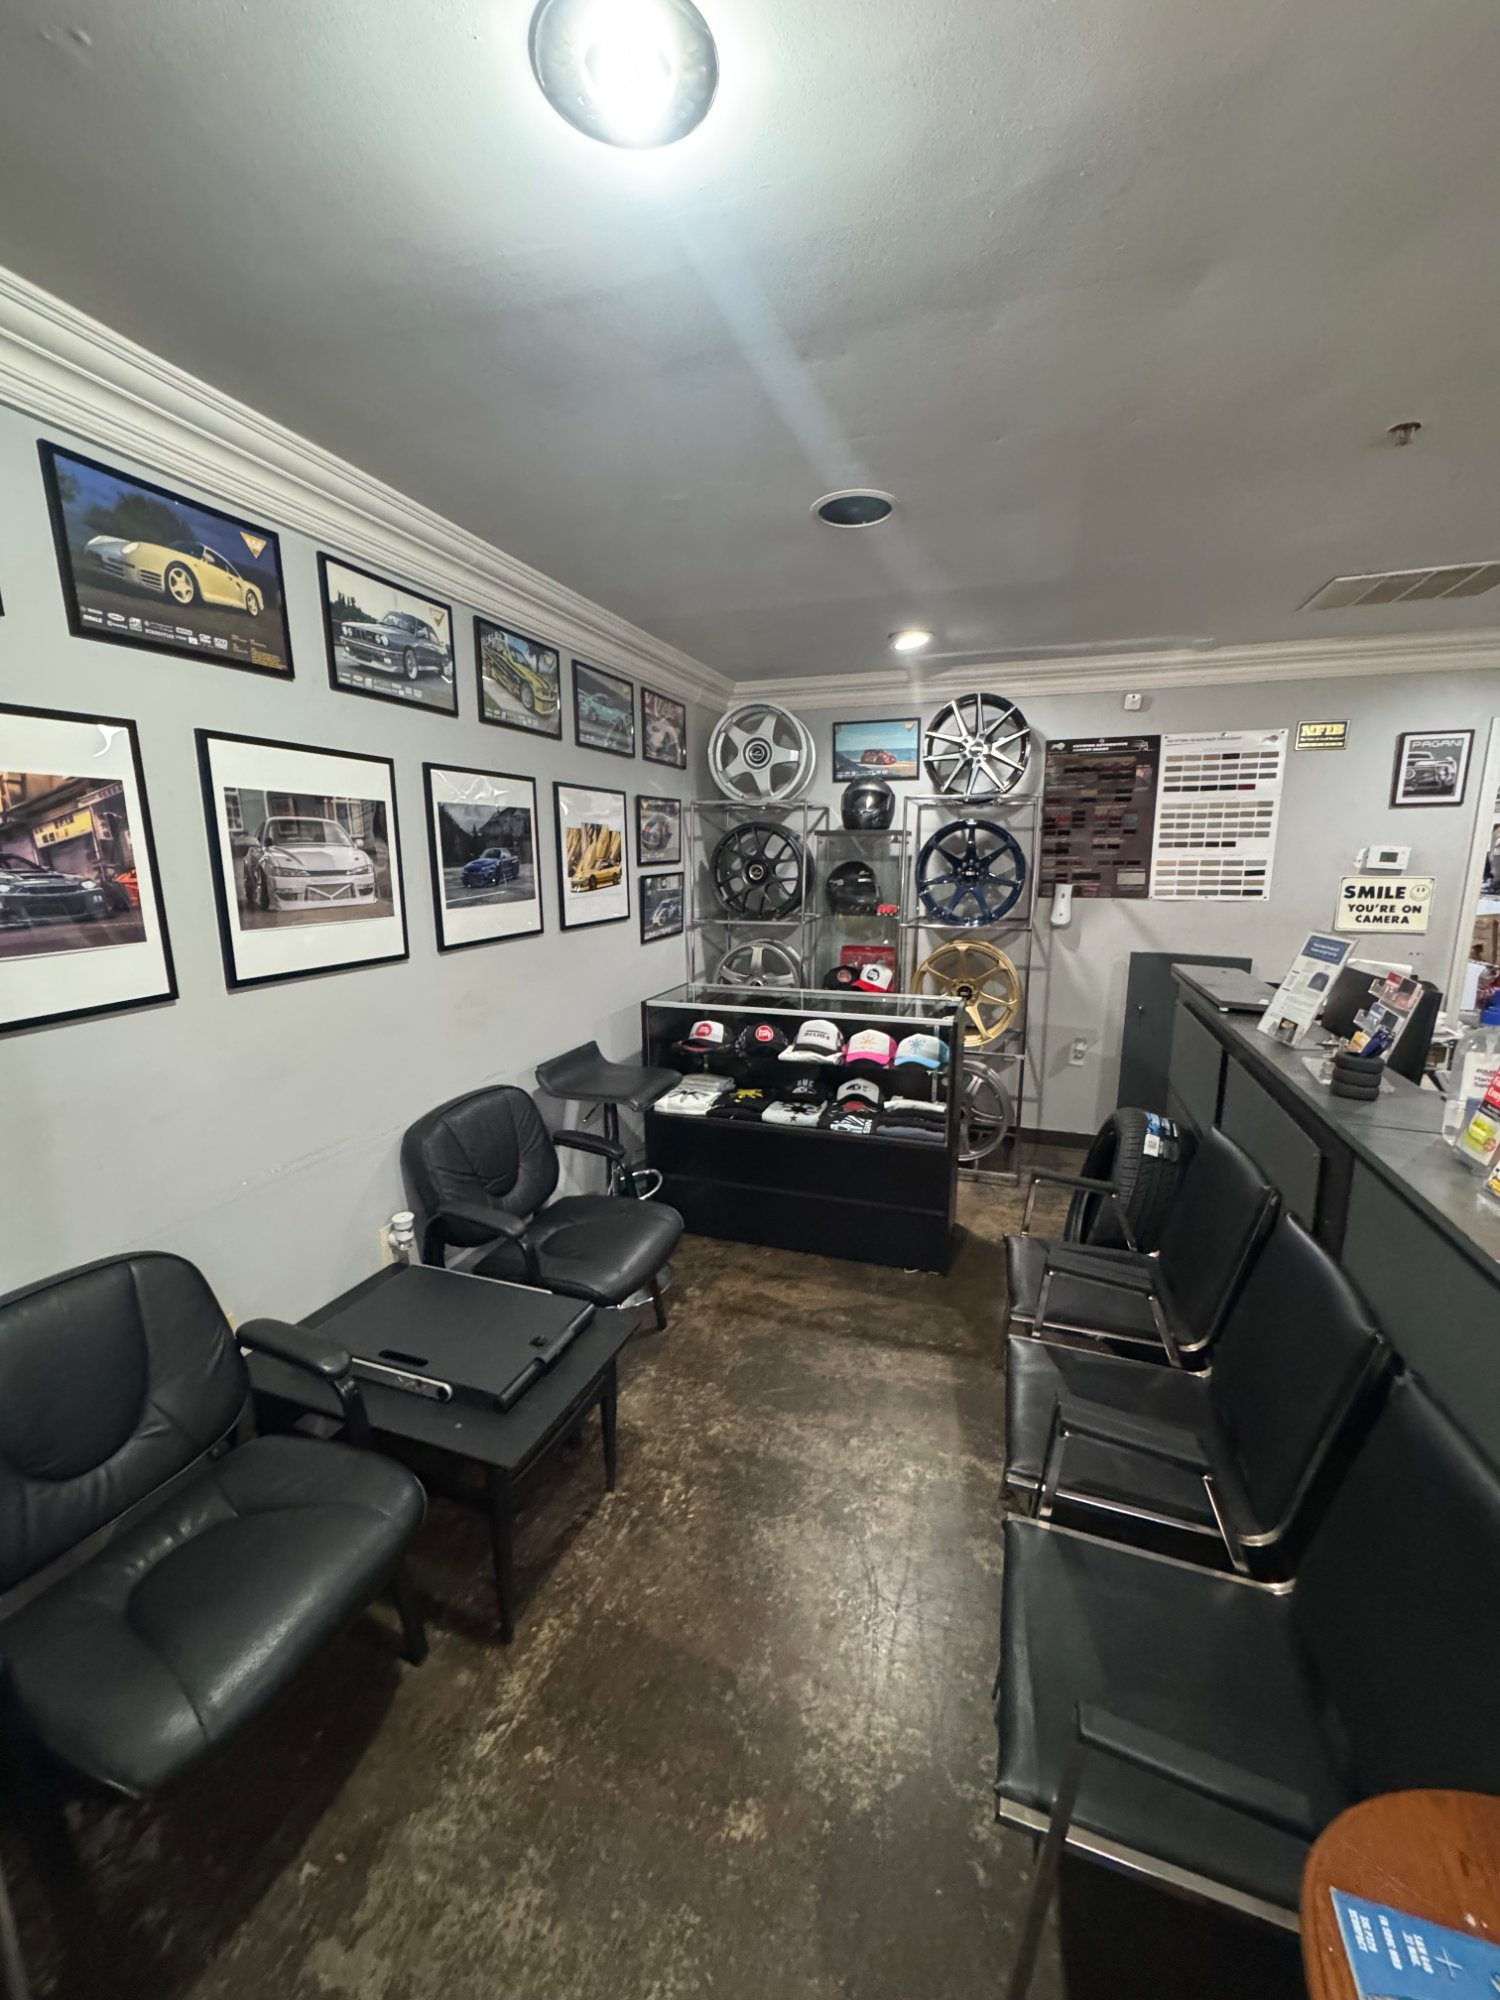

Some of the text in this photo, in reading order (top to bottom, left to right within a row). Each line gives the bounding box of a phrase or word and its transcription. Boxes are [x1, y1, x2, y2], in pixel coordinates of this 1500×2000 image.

[1411, 739, 1462, 748] PAGANI
[1343, 885, 1406, 900] SMILE
[1347, 903, 1422, 914] YOU'RE ON
[1354, 914, 1410, 925] CAMERA
